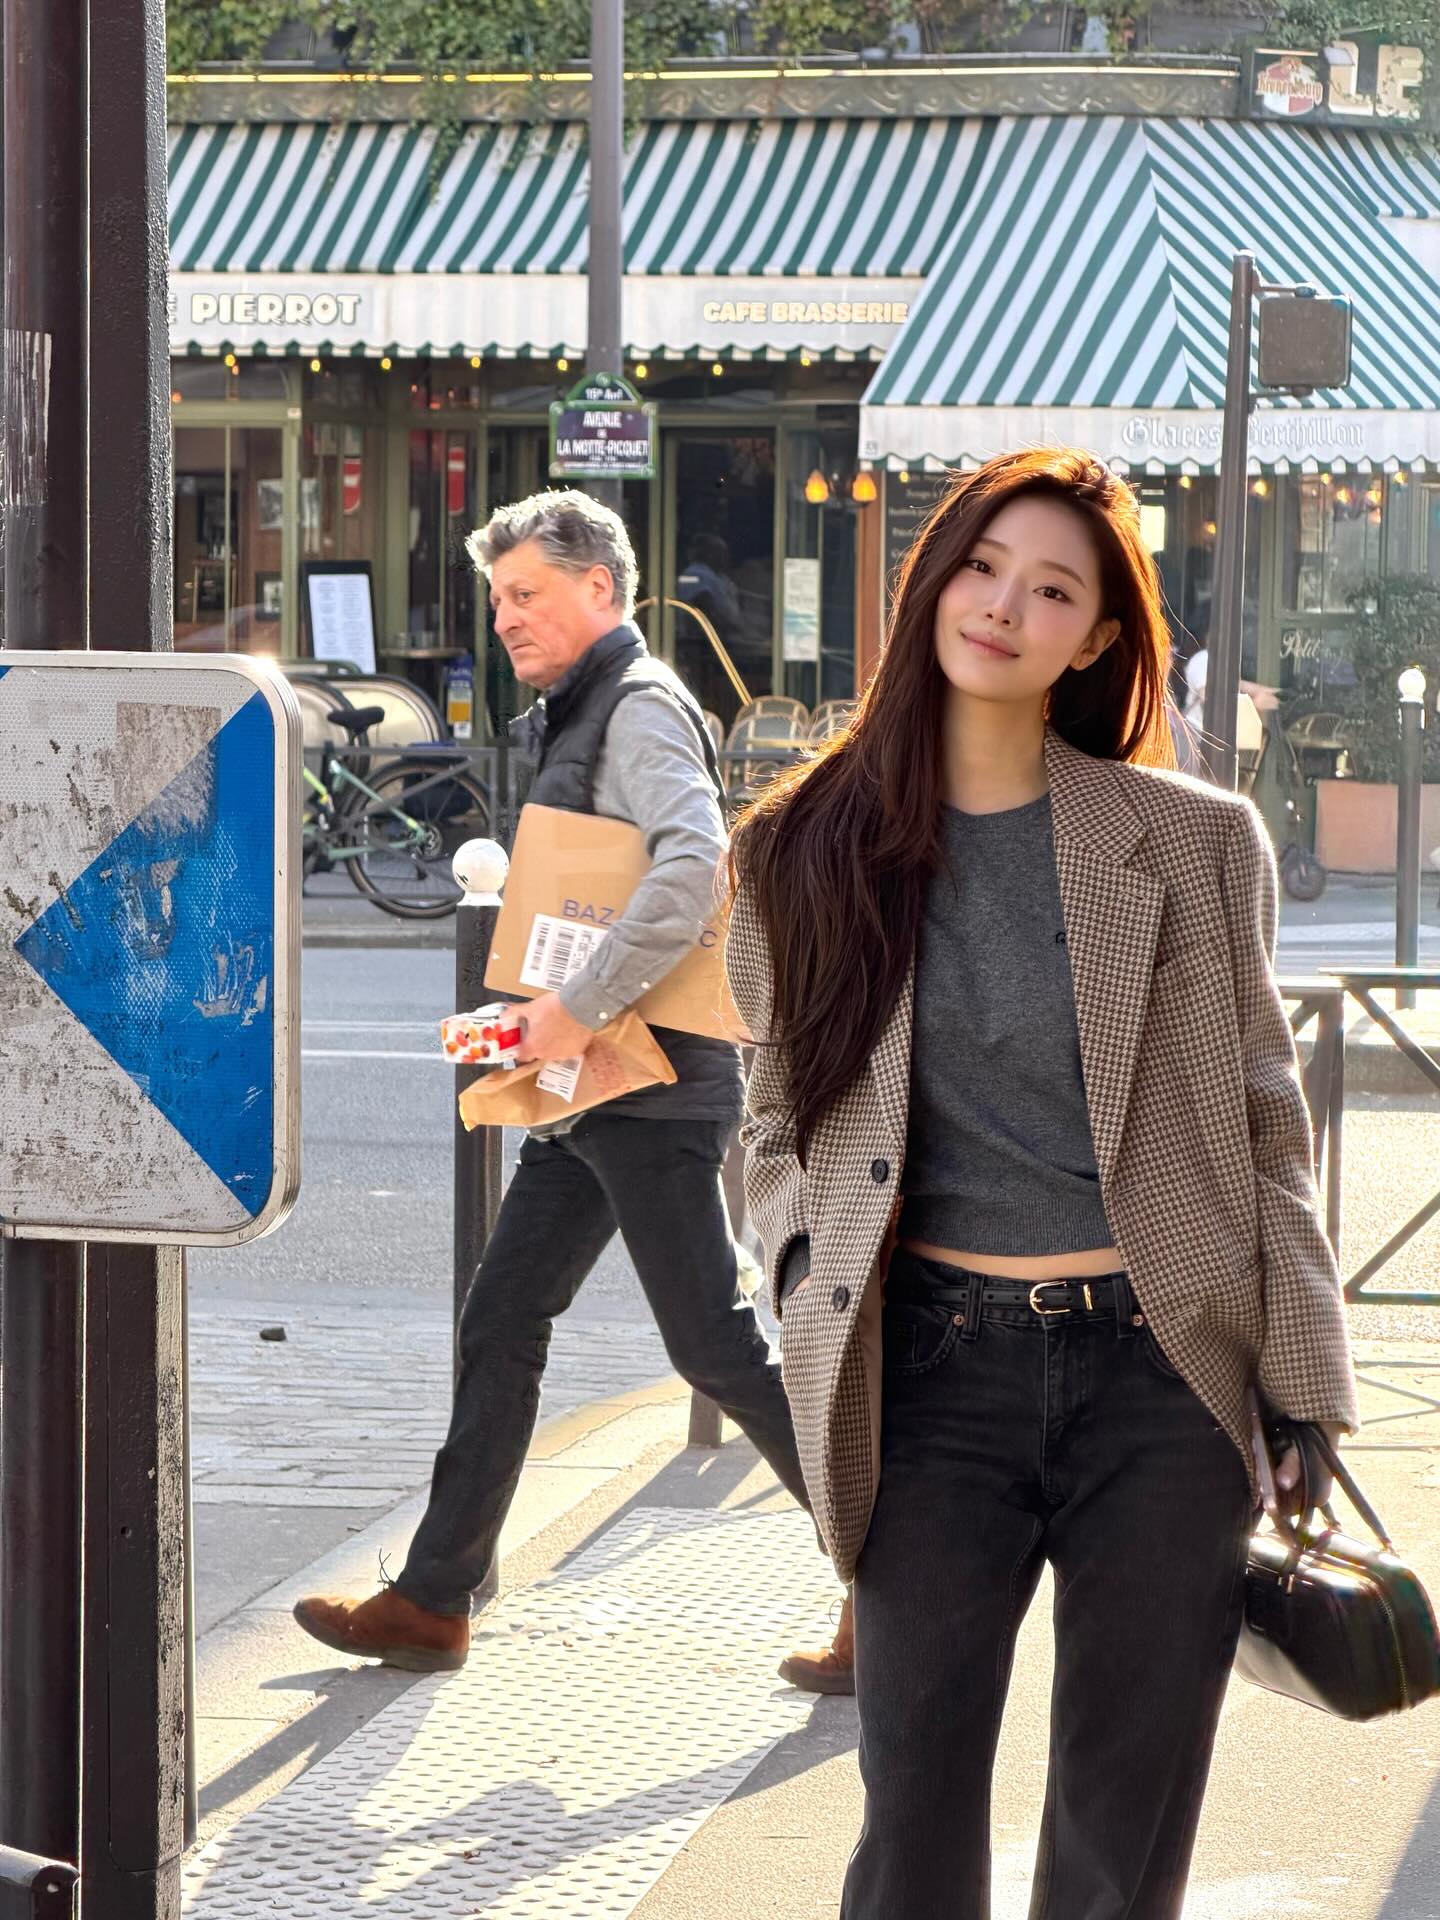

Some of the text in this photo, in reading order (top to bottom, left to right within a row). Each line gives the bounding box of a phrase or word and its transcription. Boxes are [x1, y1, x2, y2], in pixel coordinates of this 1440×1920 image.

[1325, 40, 1425, 120] LE
[190, 292, 361, 326] PIERROT
[771, 301, 909, 324] BRASSERIE
[583, 411, 622, 428] AVENUE
[1121, 416, 1222, 448] Glaces
[556, 439, 648, 457] LA MOTTE-PICQUET
[563, 899, 615, 926] BAZ
